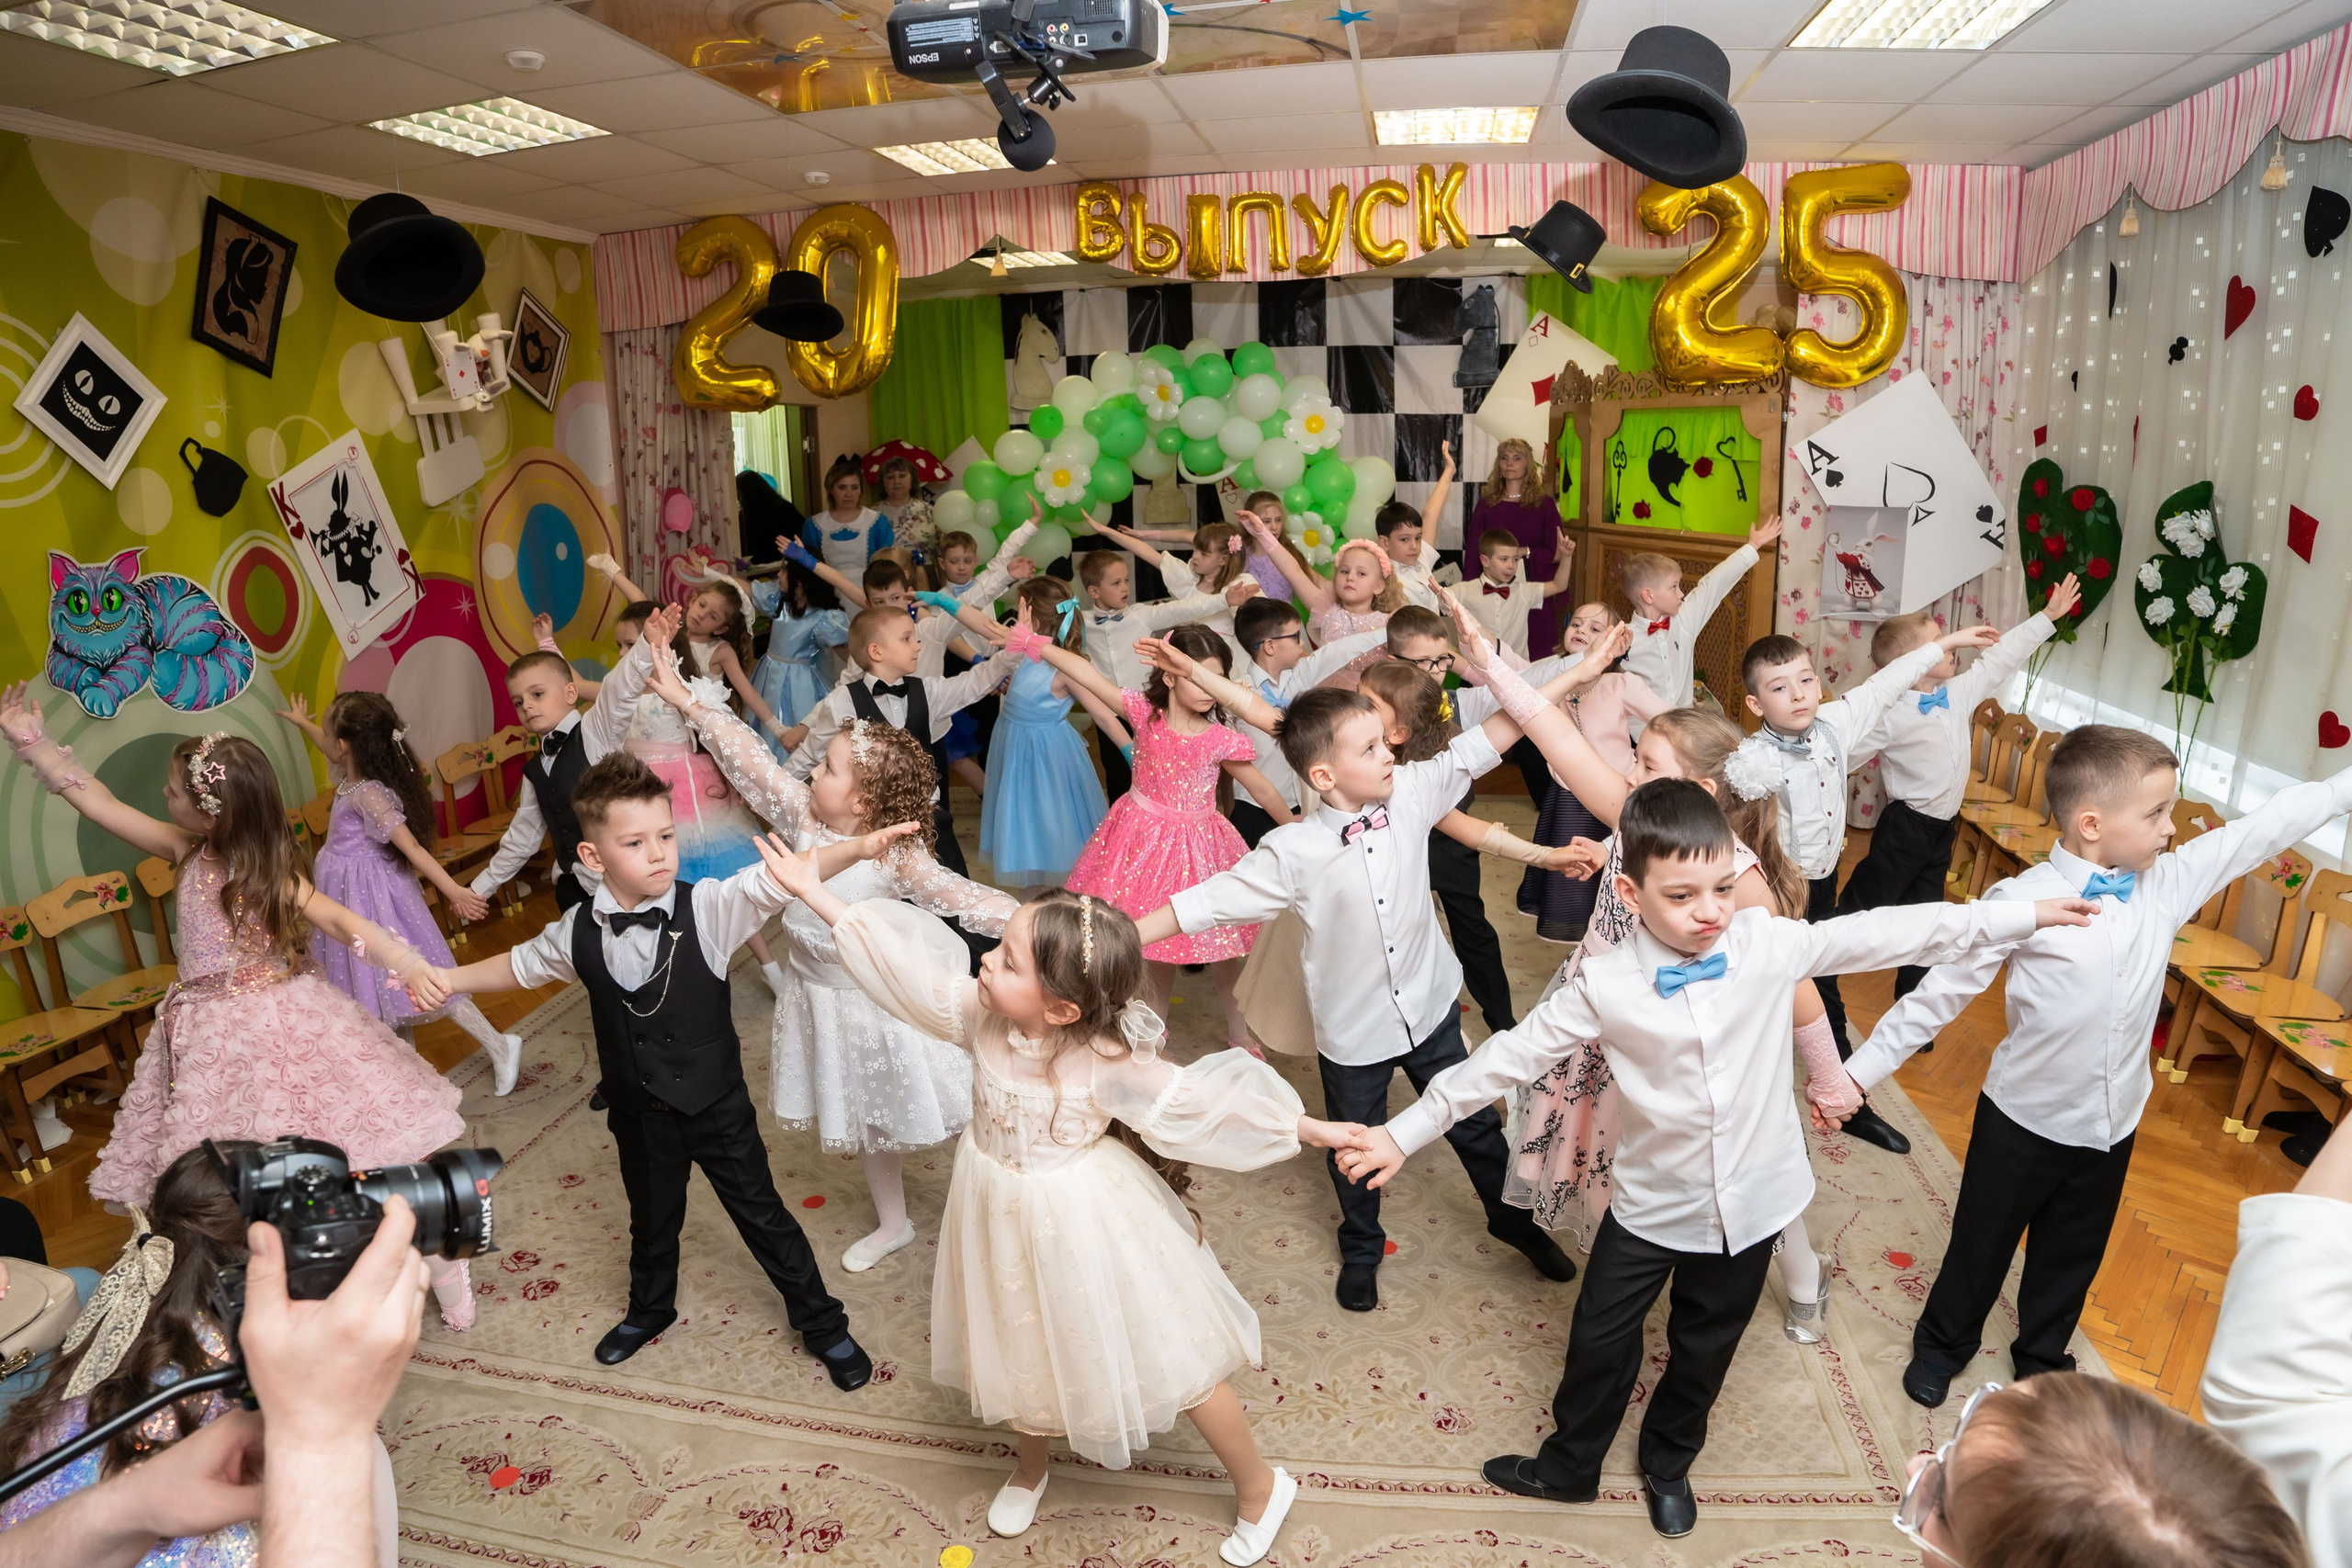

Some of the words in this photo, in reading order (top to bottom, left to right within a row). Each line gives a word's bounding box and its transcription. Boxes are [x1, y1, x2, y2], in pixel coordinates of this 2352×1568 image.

[909, 51, 940, 64] EPSON
[1075, 162, 1469, 279] ВЫПУСК
[1637, 163, 1912, 390] 25
[674, 203, 899, 413] 20
[1530, 315, 1549, 338] A
[1807, 440, 1839, 475] A
[271, 481, 300, 526] K
[1220, 477, 1239, 494] A
[401, 561, 426, 601] K
[476, 1197, 492, 1253] LUMIX
